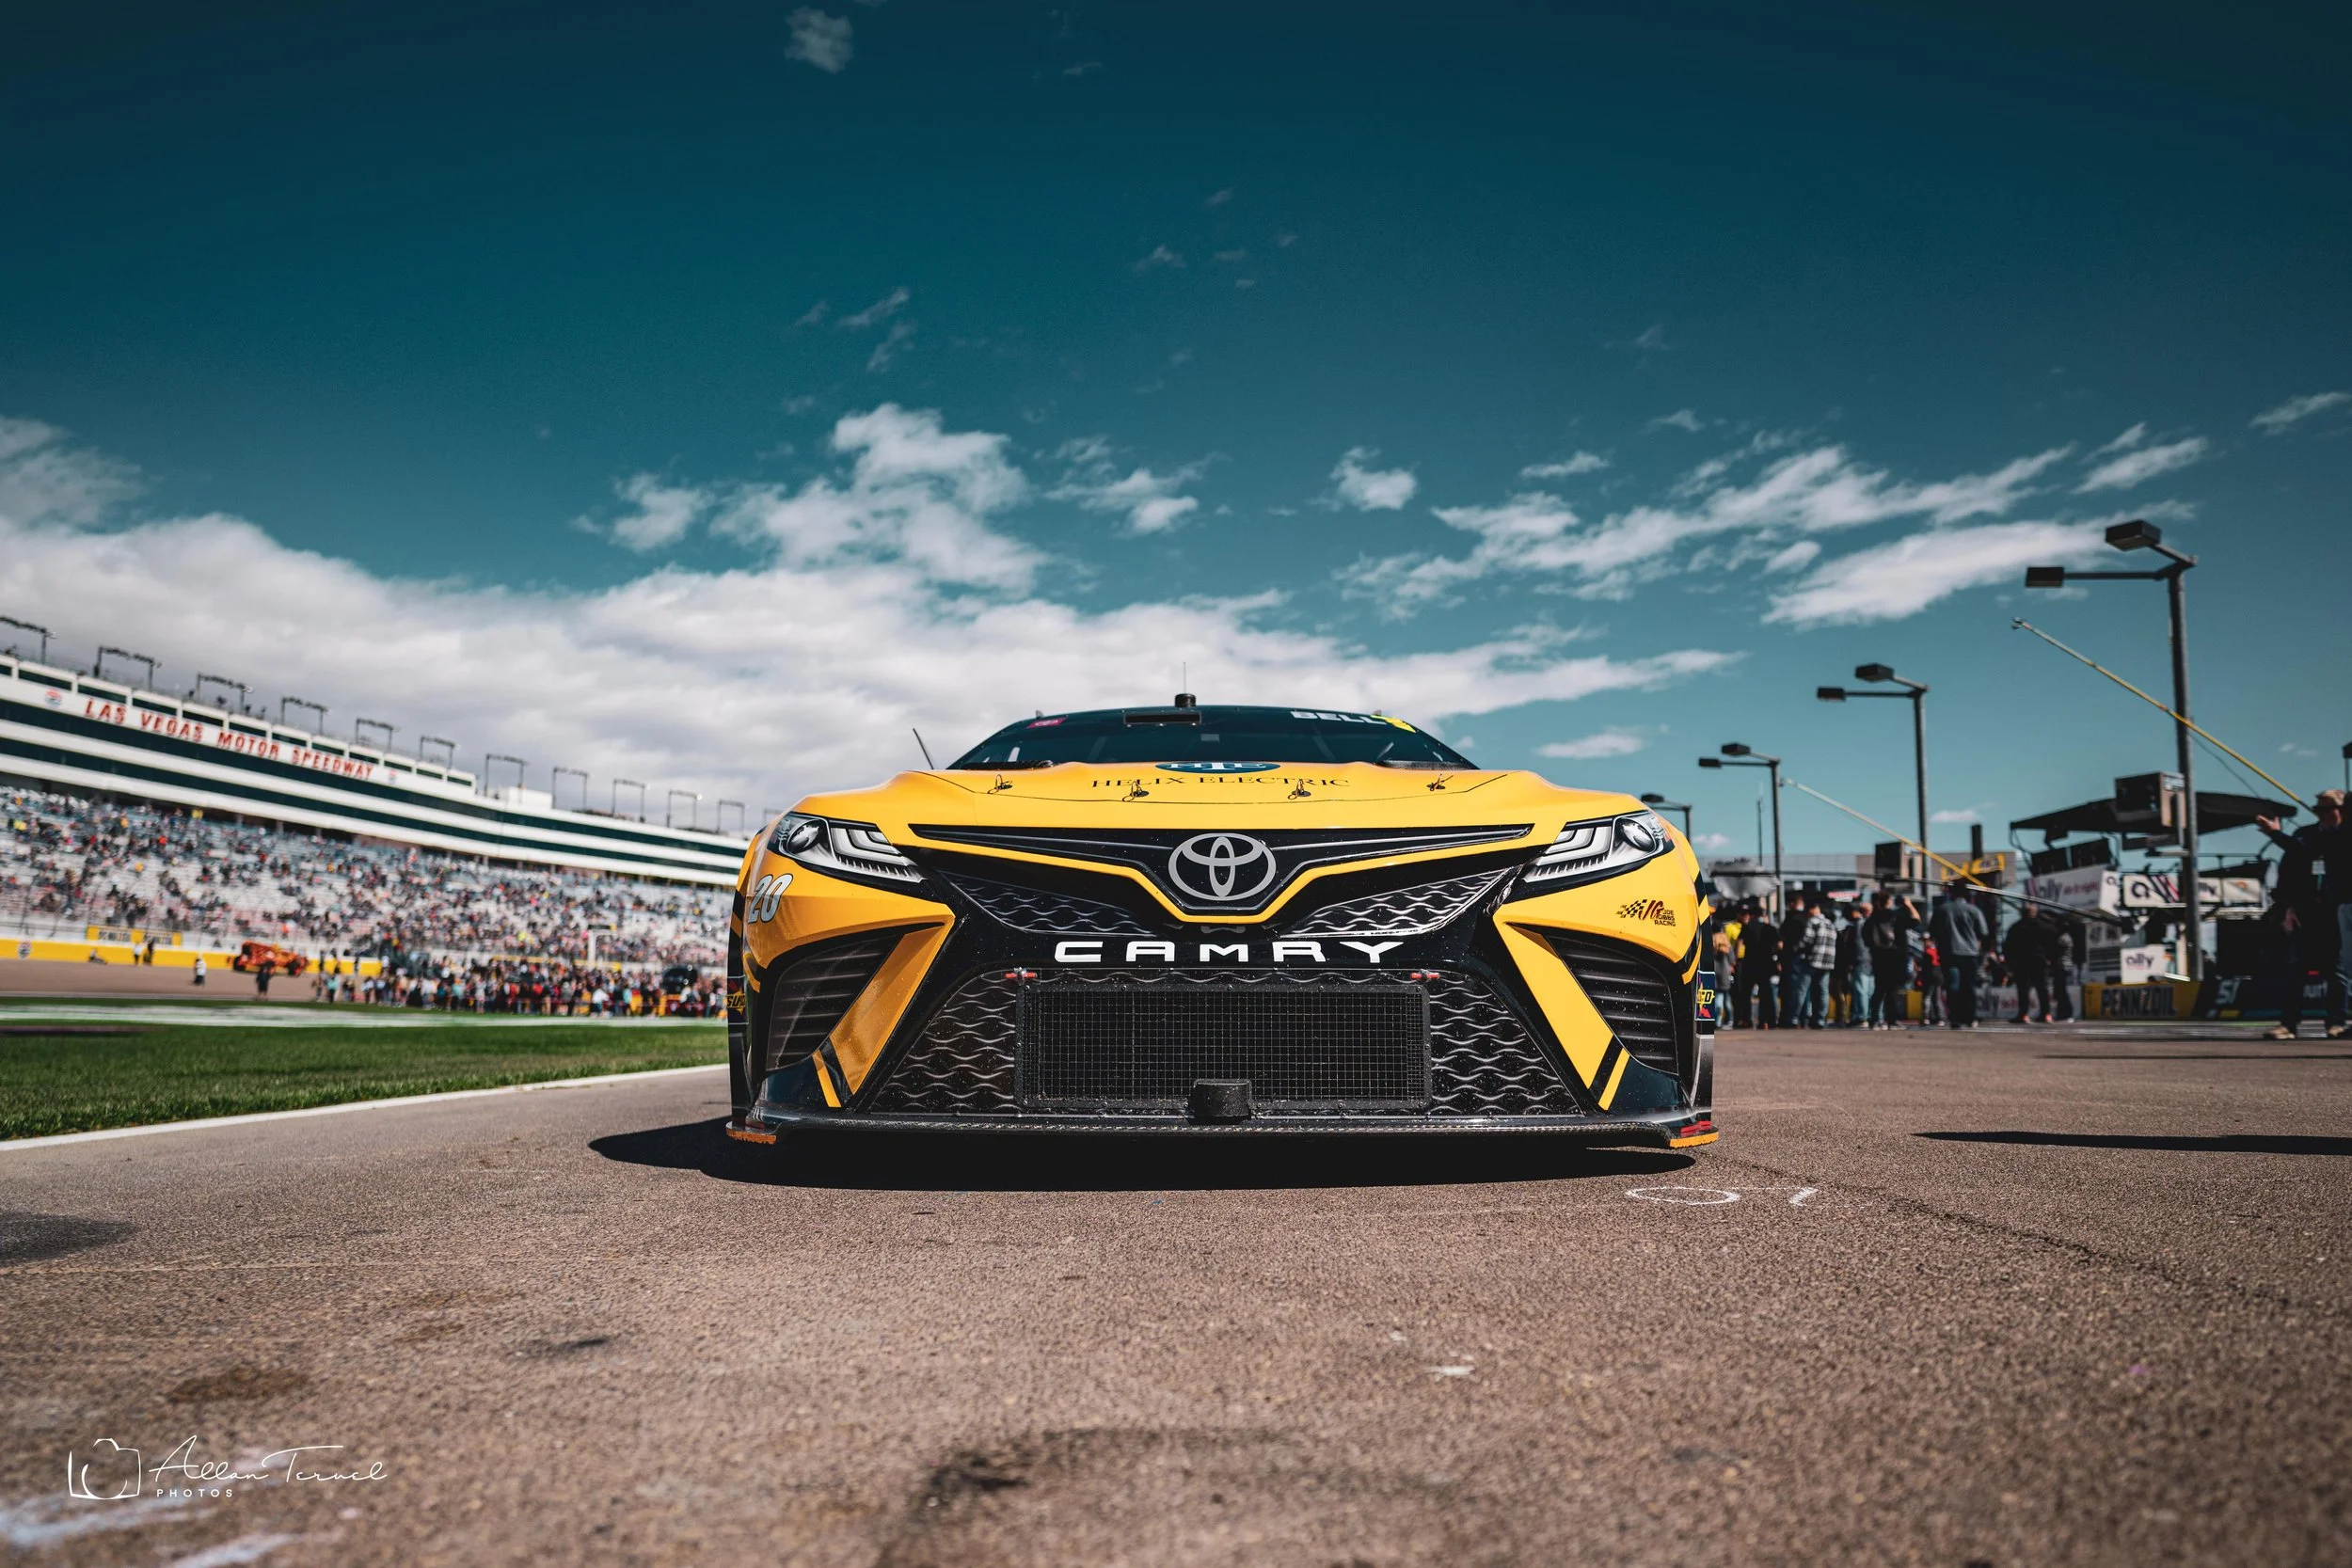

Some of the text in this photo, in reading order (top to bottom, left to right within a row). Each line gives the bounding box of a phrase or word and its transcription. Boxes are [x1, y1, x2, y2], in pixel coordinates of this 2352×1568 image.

[84, 697, 373, 781] LAS VEGAS MOTOR SPEEDWAY
[1092, 777, 1350, 787] HELIX ELECTRIC
[748, 873, 793, 924] 20
[1055, 941, 1405, 963] CAMRY
[2125, 952, 2154, 971] ally
[2101, 985, 2178, 1018] PENNZOIL
